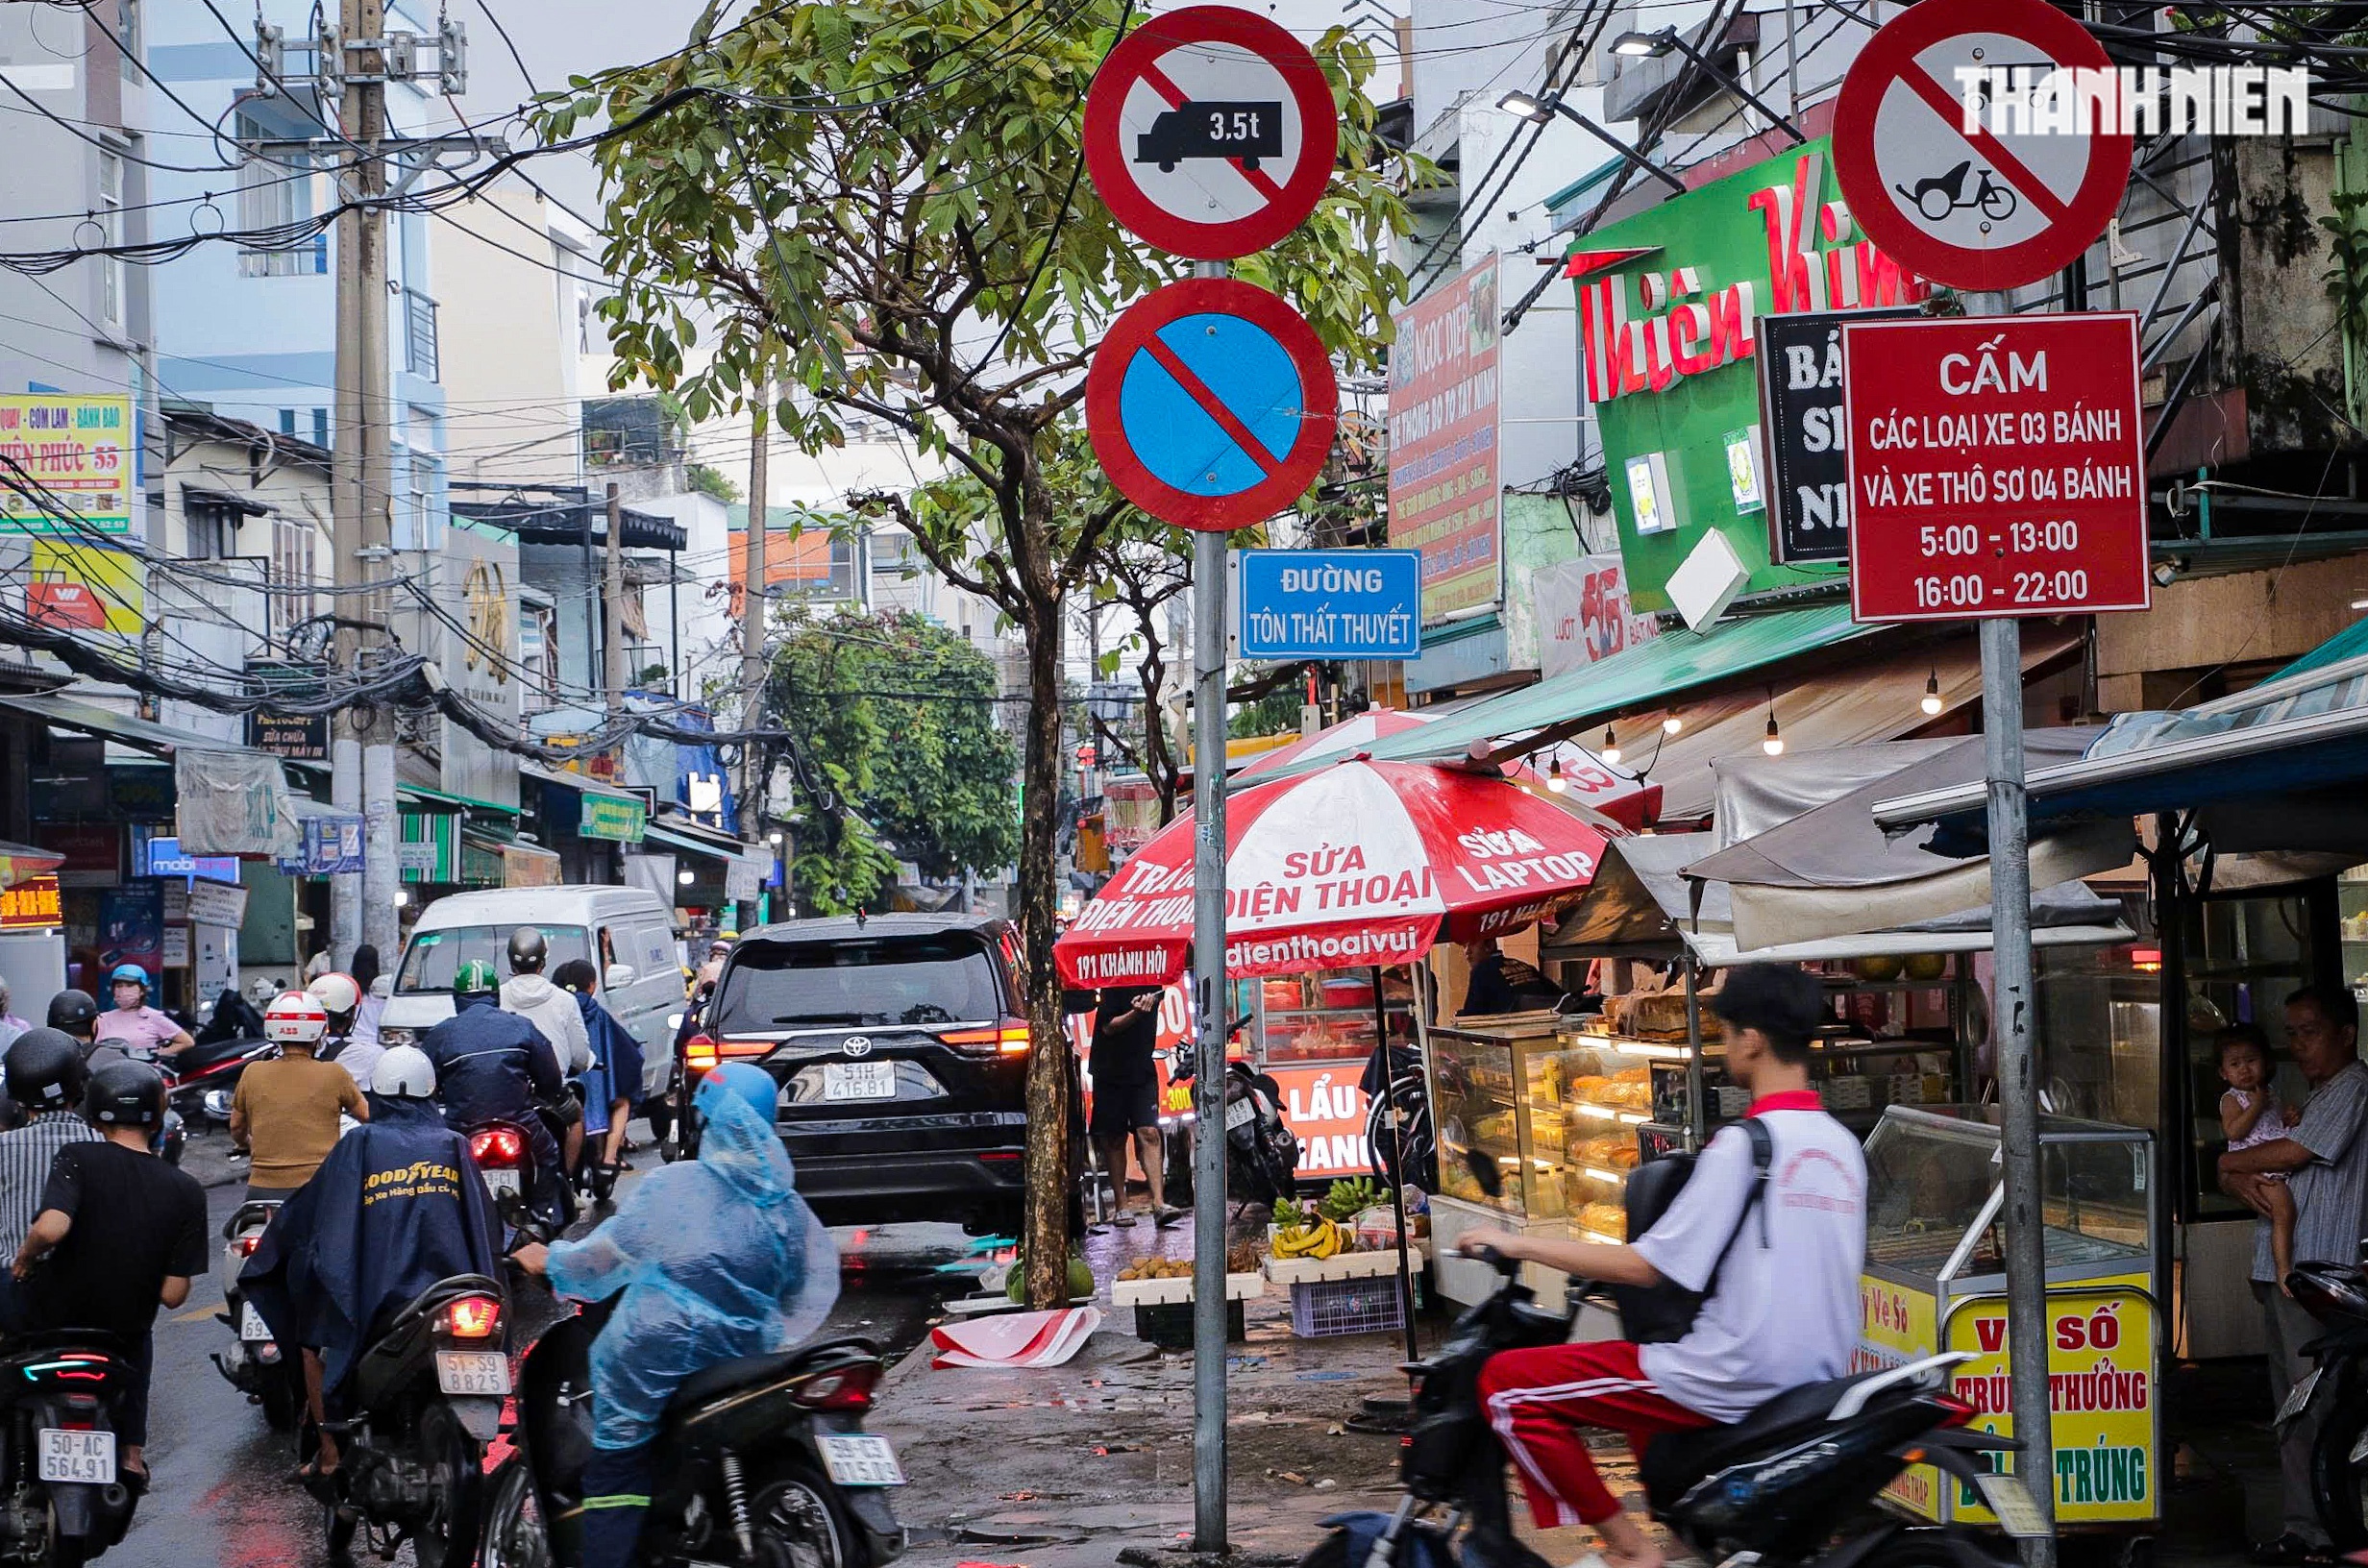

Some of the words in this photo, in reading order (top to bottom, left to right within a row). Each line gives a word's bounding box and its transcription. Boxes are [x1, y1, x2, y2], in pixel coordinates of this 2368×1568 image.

[1562, 245, 1755, 404] Thiên
[1785, 328, 1842, 390] BÁ
[1938, 333, 2048, 396] CẤM
[1473, 366, 1497, 412] NINH
[51, 407, 68, 429] LAM
[77, 404, 100, 429] BÁNH
[102, 407, 120, 429] BAO
[1869, 407, 1917, 451] CÁC
[1923, 413, 1978, 455] LOẠI
[1985, 412, 2014, 446] XE
[2020, 410, 2047, 445] 03
[2054, 401, 2122, 445] BÁNH
[39, 434, 85, 473] PHÚC
[93, 446, 118, 470] 55
[1863, 465, 1898, 508] VÀ
[1902, 472, 1935, 506] XE
[1937, 463, 1986, 504] THÔ
[1992, 469, 2026, 502] SƠ
[2031, 468, 2057, 502] 04
[2063, 457, 2132, 501] BÁNH
[1920, 525, 1979, 558] 5:00
[2010, 520, 2078, 554] 13:00
[1280, 563, 1382, 594] ĐƯỜNG
[1914, 575, 1984, 608] 16:00
[2013, 570, 2087, 603] 22:00
[1249, 606, 1286, 644] TÔN
[1291, 601, 1337, 644] THẤT
[1341, 602, 1411, 645] THUYẾT
[1283, 841, 1366, 879] SỬA
[1456, 825, 1545, 859] SỬA
[1315, 866, 1433, 911] THOẠI
[1455, 850, 1593, 893] LAPTOP
[1073, 894, 1146, 938] ĐIỆN
[1132, 894, 1195, 932] THOẠ
[1480, 909, 1510, 933] 191
[1075, 954, 1098, 980] 191
[1099, 945, 1145, 978] KHÁNH
[1145, 947, 1168, 985] HỘI
[1226, 926, 1417, 968] dienthoaivui
[844, 1064, 875, 1080] 51H
[1289, 1073, 1357, 1122] LẨU
[1975, 1318, 2007, 1353] V
[2055, 1301, 2120, 1351] SỐ
[2048, 1356, 2148, 1412] THƯỞNG
[51, 1434, 103, 1457] 50-AC
[2055, 1433, 2145, 1505] TRÚNG
